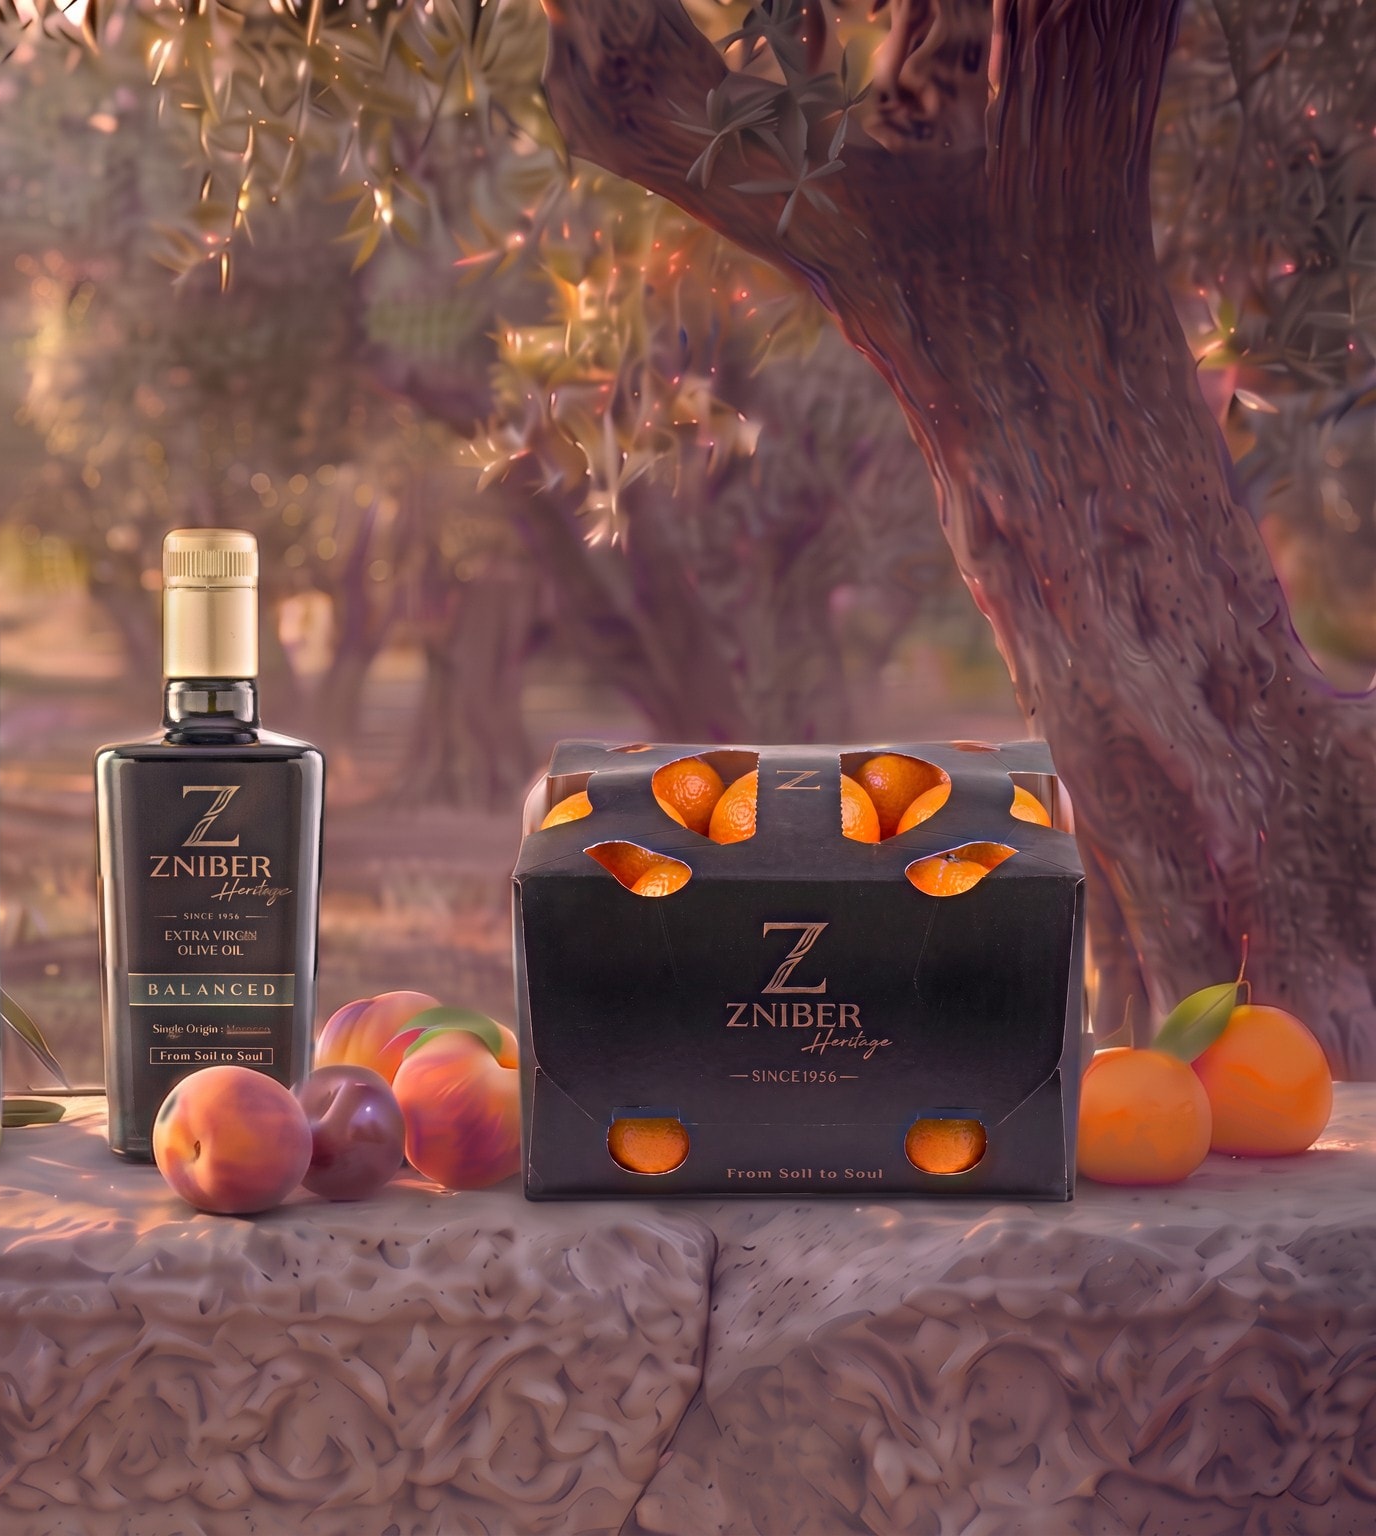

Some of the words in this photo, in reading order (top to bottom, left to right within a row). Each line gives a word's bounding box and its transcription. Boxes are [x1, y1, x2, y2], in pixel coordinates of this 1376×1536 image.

[776, 770, 821, 790] Z
[181, 785, 241, 847] Z
[149, 855, 272, 878] ZNIBER
[210, 878, 293, 907] Heritage
[183, 912, 214, 920] SINCE
[218, 912, 240, 920] 1956
[165, 930, 210, 941] EXTRA
[177, 944, 218, 956] OLIVE
[221, 944, 244, 956] OIL
[761, 922, 829, 994] Z
[148, 983, 275, 996] BALANCED
[726, 1003, 862, 1028] ZNIBER
[152, 1023, 184, 1036] Single
[186, 1023, 218, 1037] Origin
[801, 1028, 894, 1060] Heritage
[160, 1051, 190, 1061] From
[194, 1051, 217, 1061] Soil
[221, 1051, 233, 1061] to
[237, 1051, 263, 1061] Soul
[726, 1168, 772, 1179] From
[820, 1169, 838, 1179] to
[844, 1168, 884, 1179] Soul
